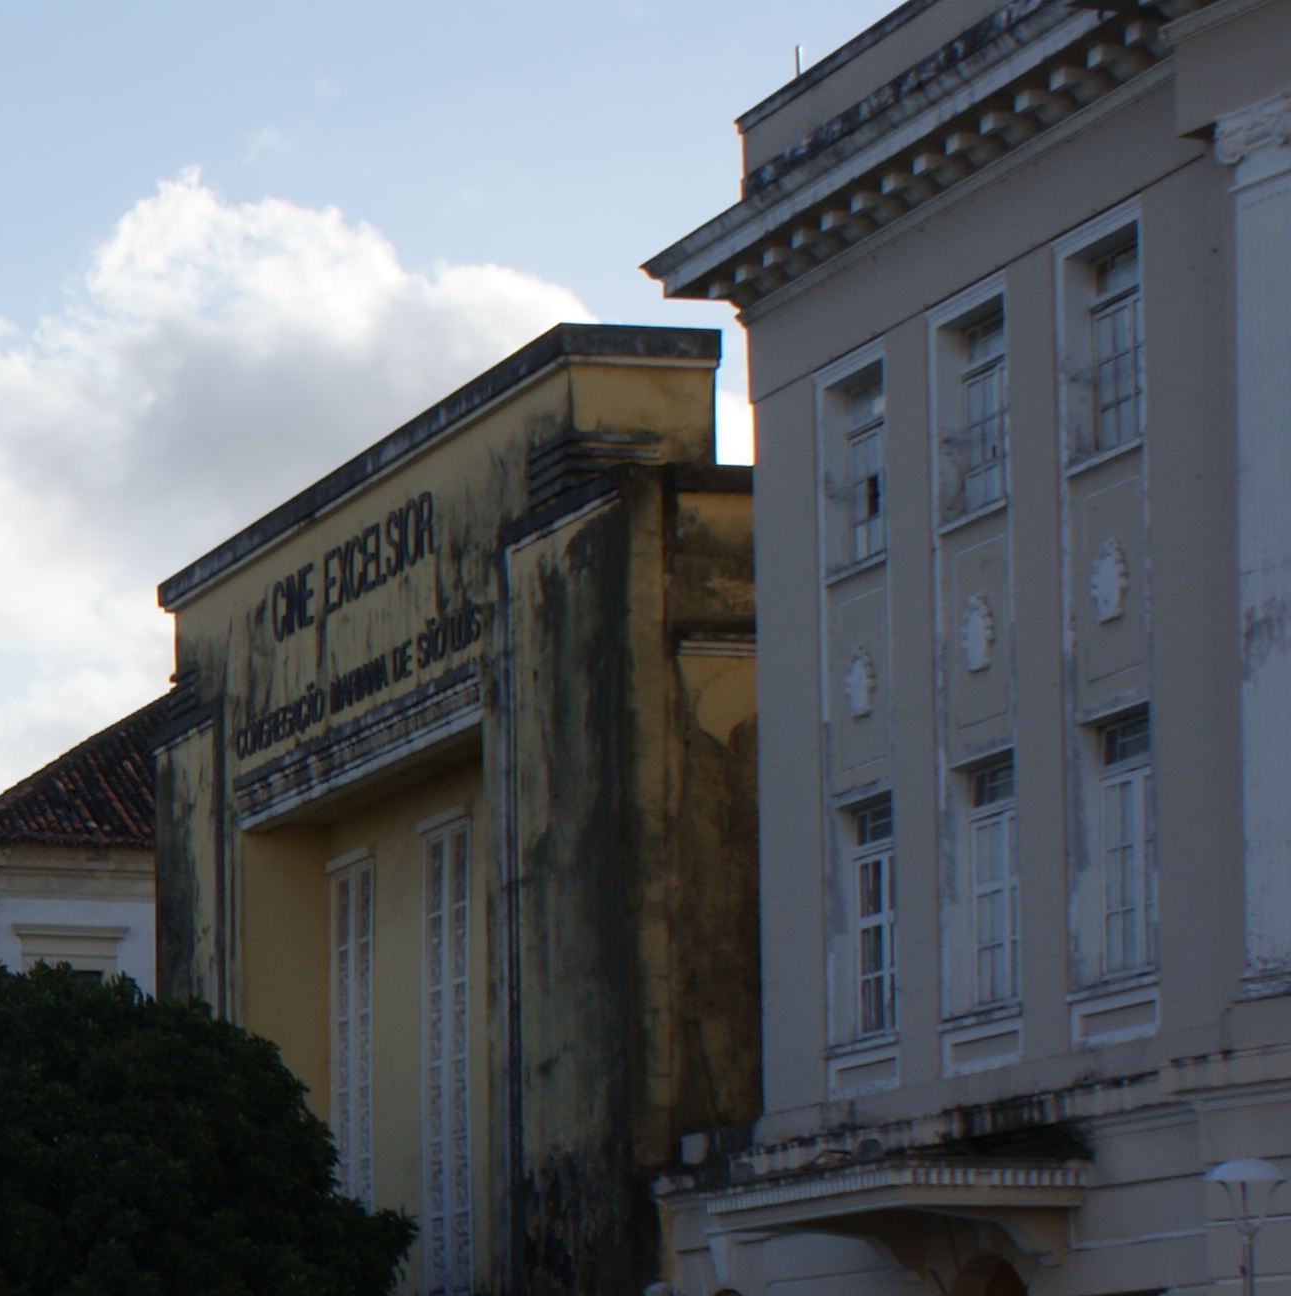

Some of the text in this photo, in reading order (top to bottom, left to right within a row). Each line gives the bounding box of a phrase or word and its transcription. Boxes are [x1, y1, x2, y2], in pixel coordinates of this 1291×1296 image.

[272, 490, 434, 642] CINE EXCELSIOR
[392, 638, 414, 683] DE
